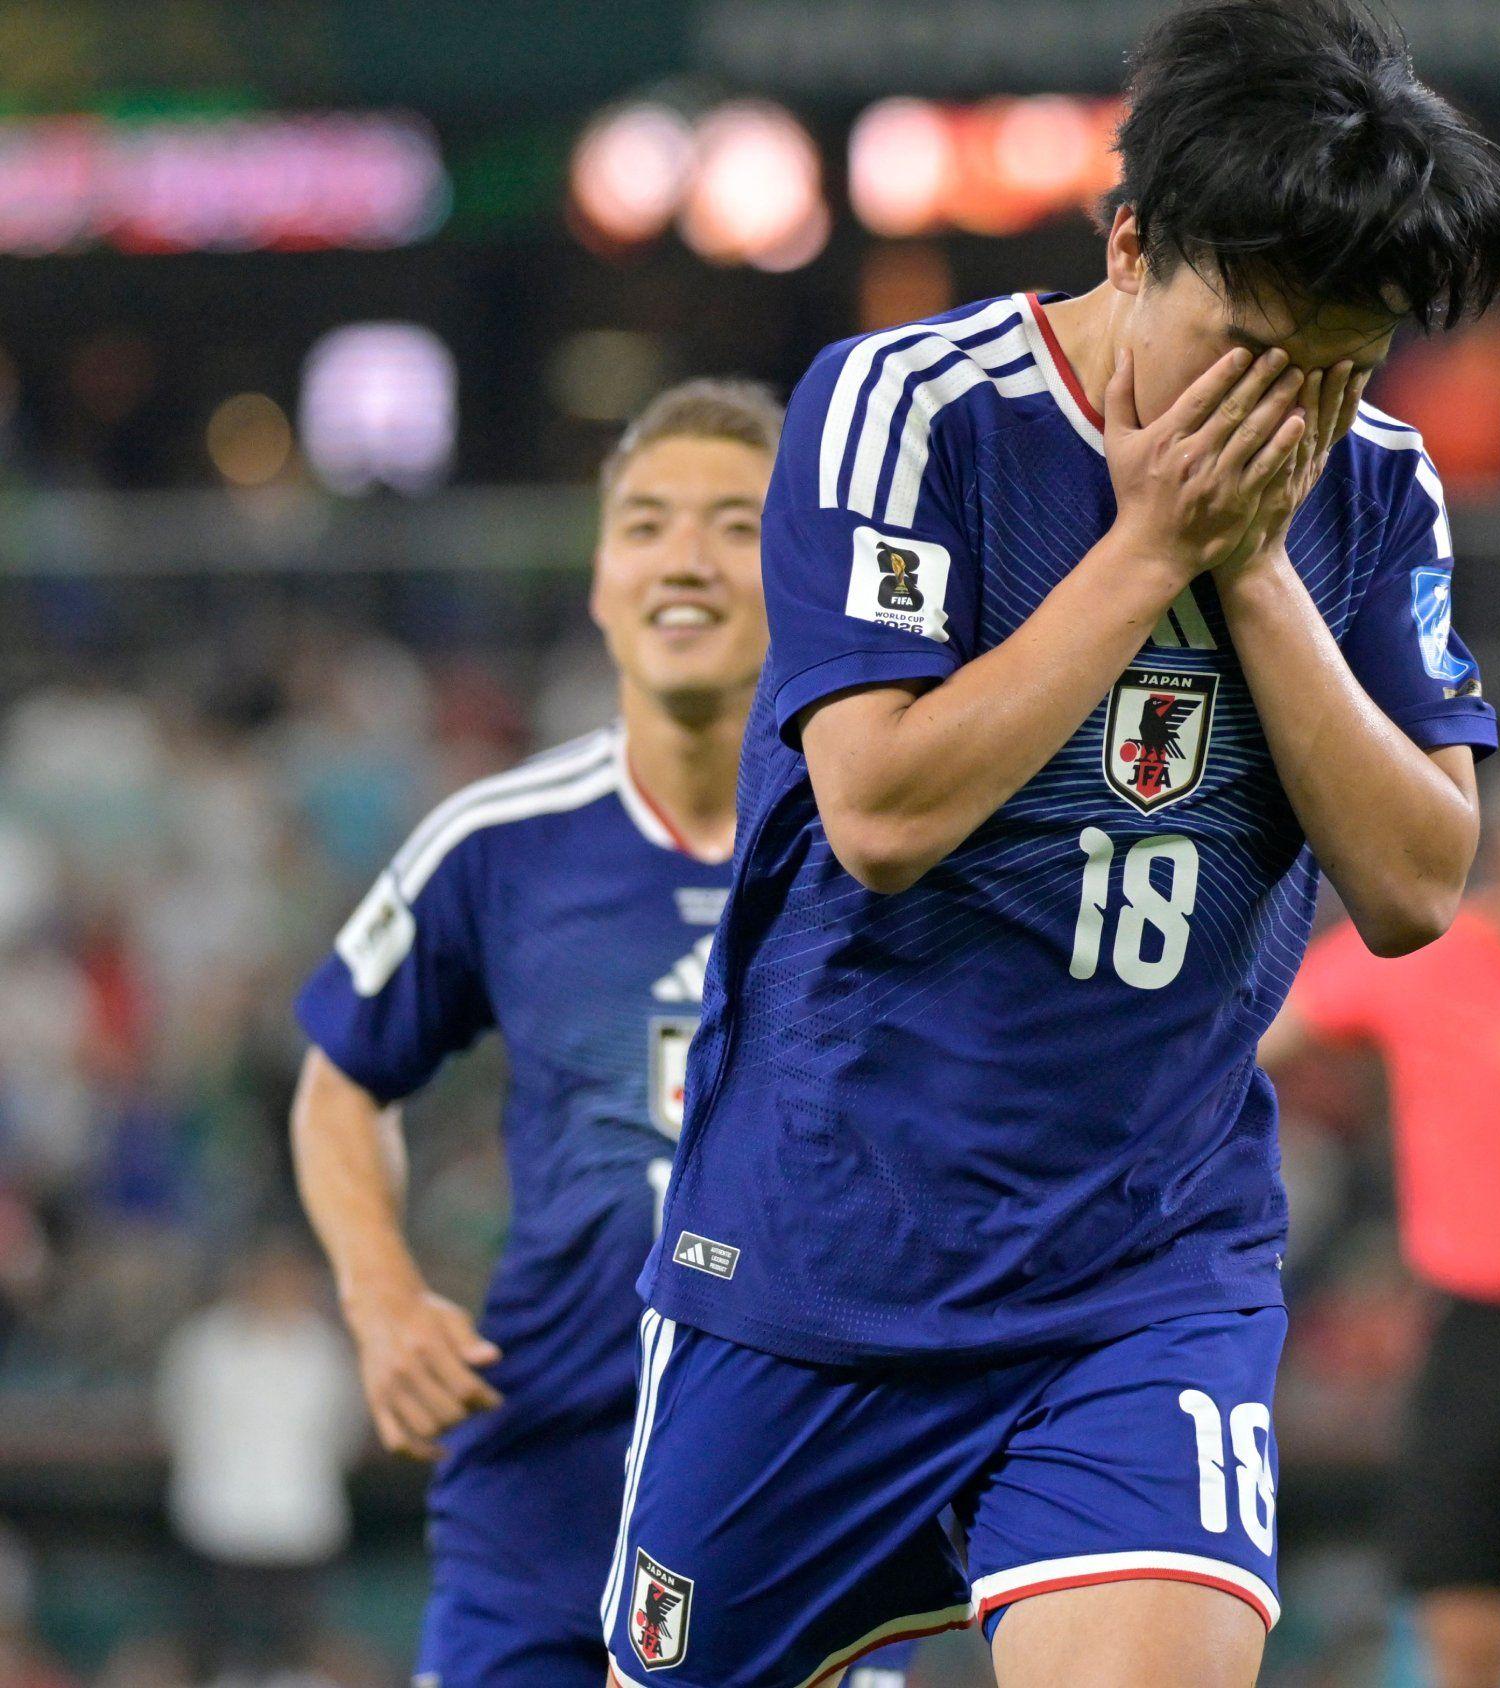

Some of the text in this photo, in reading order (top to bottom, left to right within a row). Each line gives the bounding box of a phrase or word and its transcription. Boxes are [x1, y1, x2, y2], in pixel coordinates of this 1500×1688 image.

[891, 596, 914, 606] FIFA
[875, 611, 925, 623] WORLD CUP
[1139, 674, 1193, 688] JAPAN
[1126, 765, 1172, 788] JFA
[1069, 826, 1199, 990] 18
[1178, 1389, 1275, 1557] 18
[646, 1562, 675, 1586] JAPAN
[637, 1630, 664, 1658] JFA
